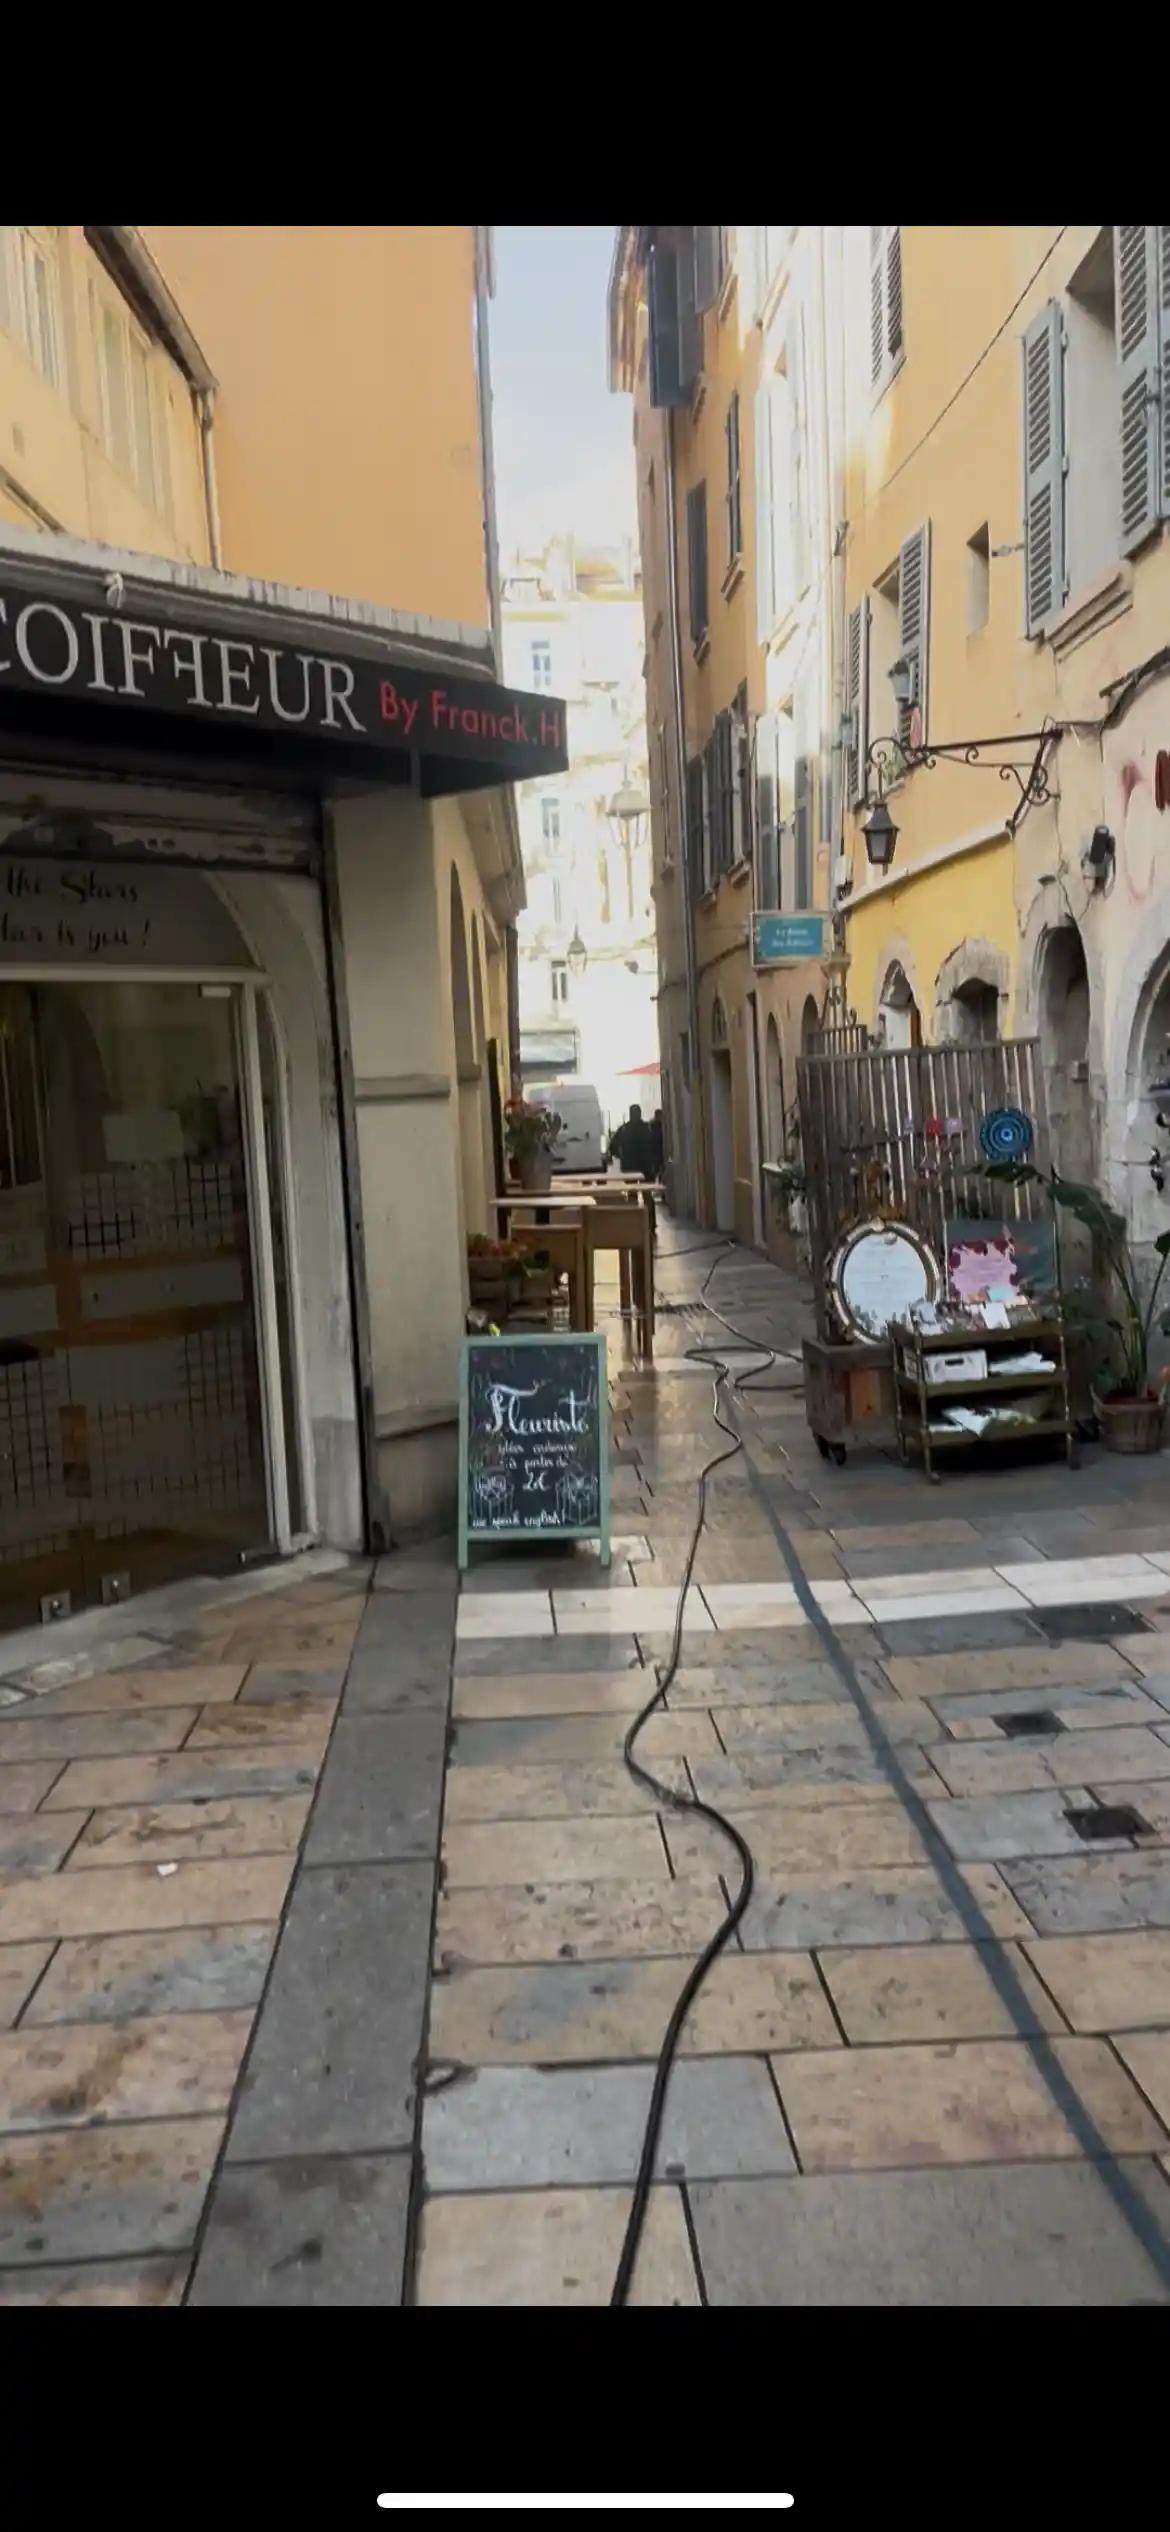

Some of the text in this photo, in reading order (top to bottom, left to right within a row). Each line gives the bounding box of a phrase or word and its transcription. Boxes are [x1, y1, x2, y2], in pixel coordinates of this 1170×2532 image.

[0, 598, 367, 732] OIFFEUR
[379, 679, 420, 735] By
[485, 1379, 590, 1437] Fleuriste
